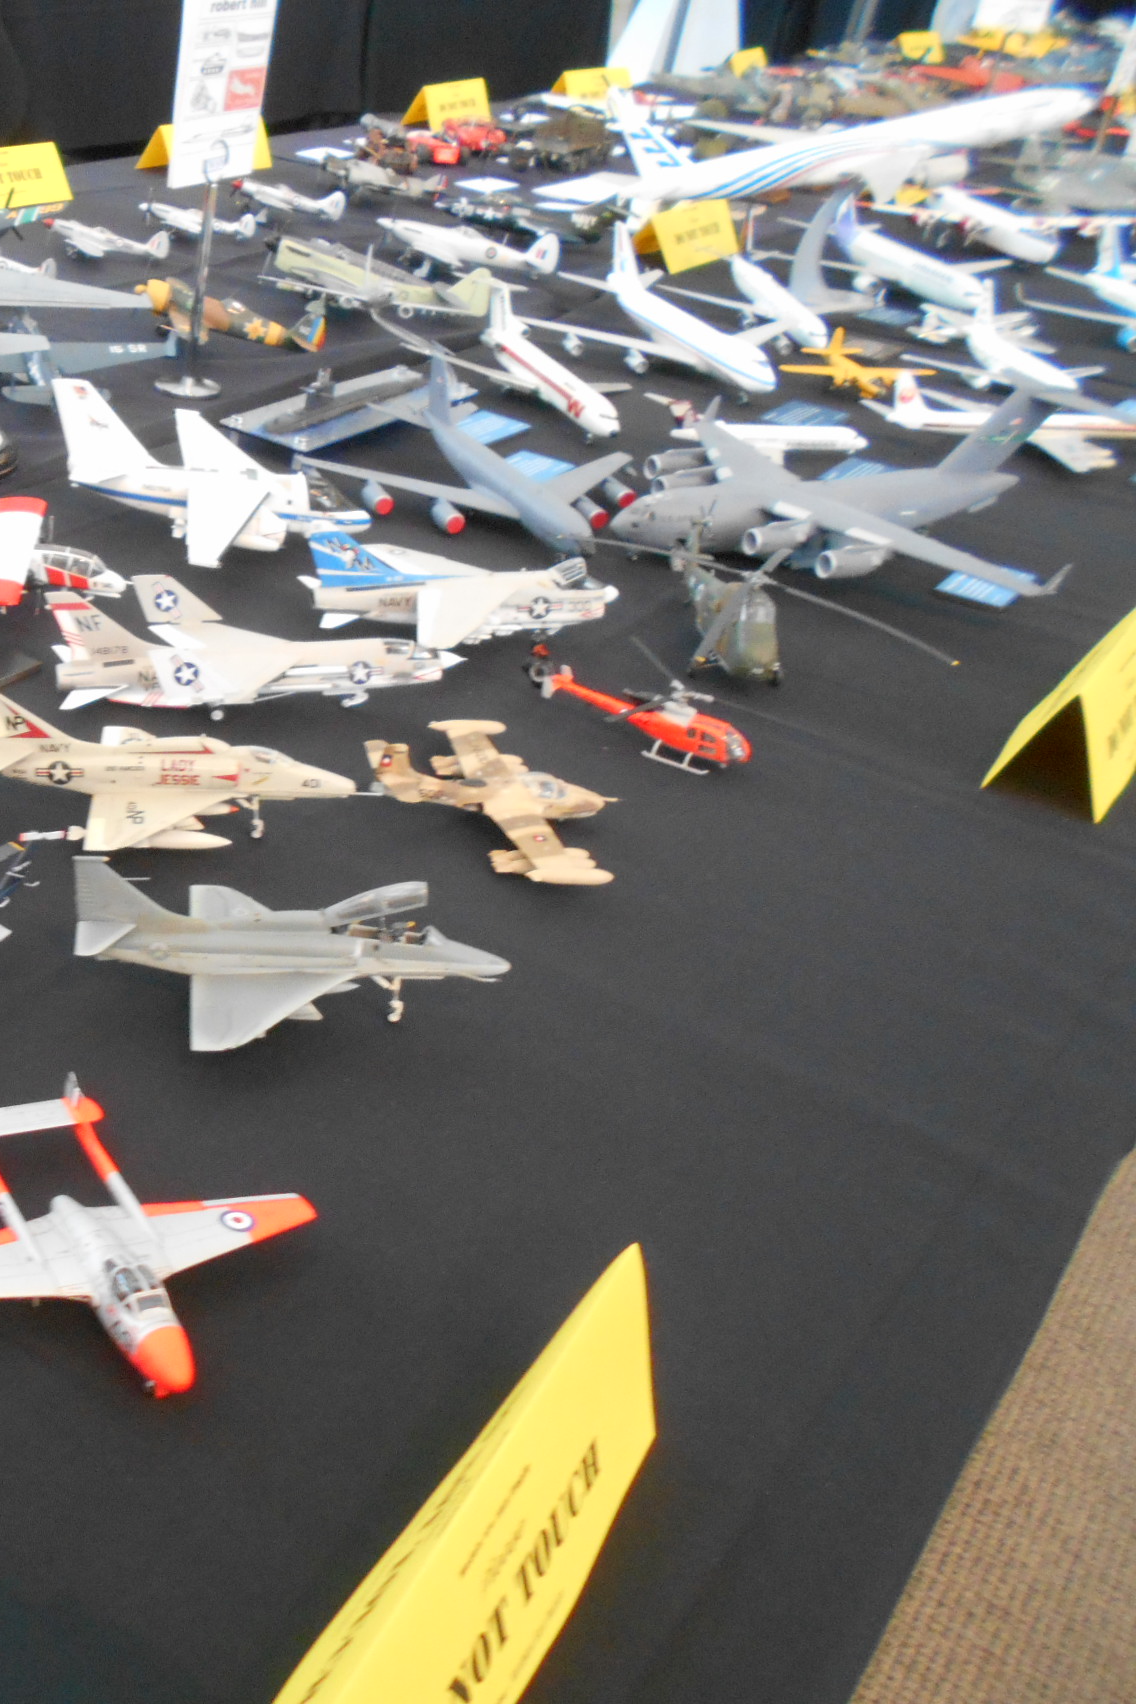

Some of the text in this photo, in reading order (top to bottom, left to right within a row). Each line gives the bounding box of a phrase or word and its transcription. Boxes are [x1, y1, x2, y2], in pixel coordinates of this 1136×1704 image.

[7, 167, 43, 182] TOUCH
[74, 613, 101, 632] NF
[5, 715, 26, 731] NP
[39, 743, 71, 752] NAVY
[160, 759, 196, 772] LADY
[152, 774, 201, 787] JESSIE
[512, 1436, 602, 1604] TOUCH
